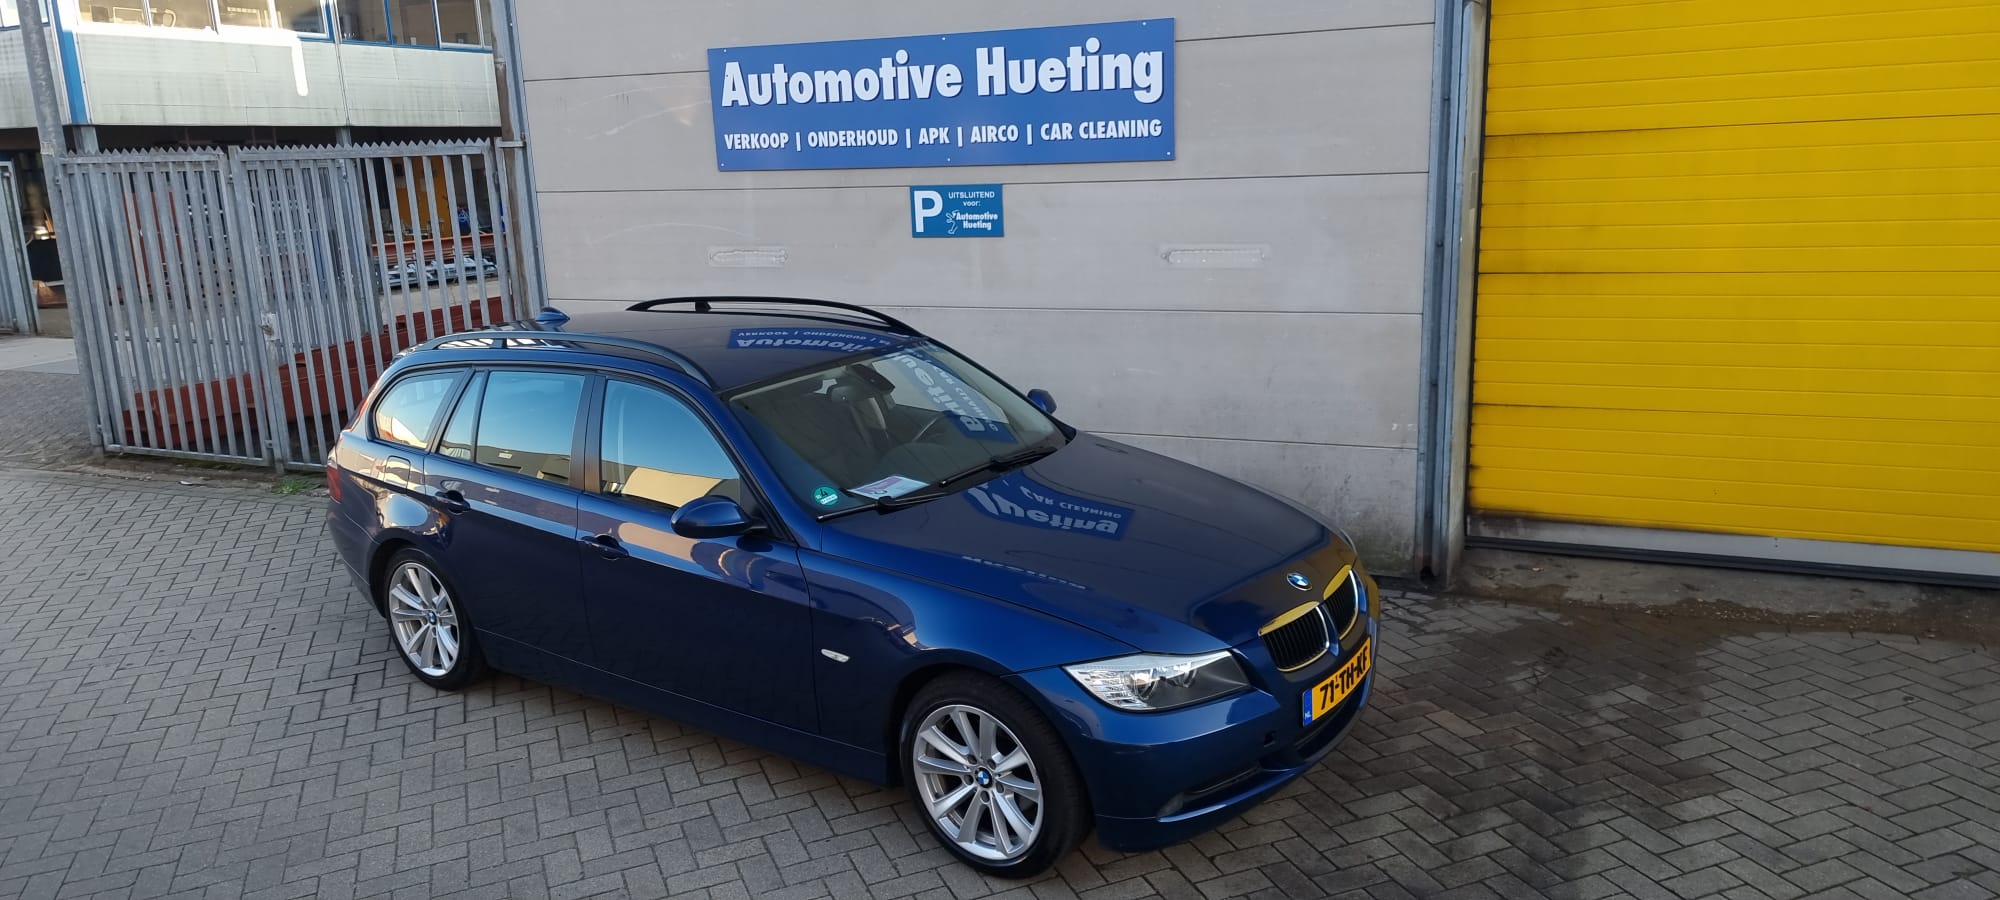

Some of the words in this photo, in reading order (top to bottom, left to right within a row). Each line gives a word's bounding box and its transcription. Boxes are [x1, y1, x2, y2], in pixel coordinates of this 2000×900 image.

[721, 49, 963, 107] Automotive
[976, 37, 1164, 104] Hueting
[723, 132, 789, 150] VERKOOP
[807, 128, 898, 148] ONDERHOUD
[918, 127, 950, 145] APK
[970, 124, 1019, 144] AIRCO
[1040, 123, 1073, 141] CAR
[1079, 119, 1162, 139] CLEANING
[948, 191, 995, 199] UITSLUITEND
[914, 190, 943, 233] P
[956, 211, 998, 221] Automotive
[963, 220, 992, 231] Hueting
[1319, 645, 1368, 711] 71-TH-KF
